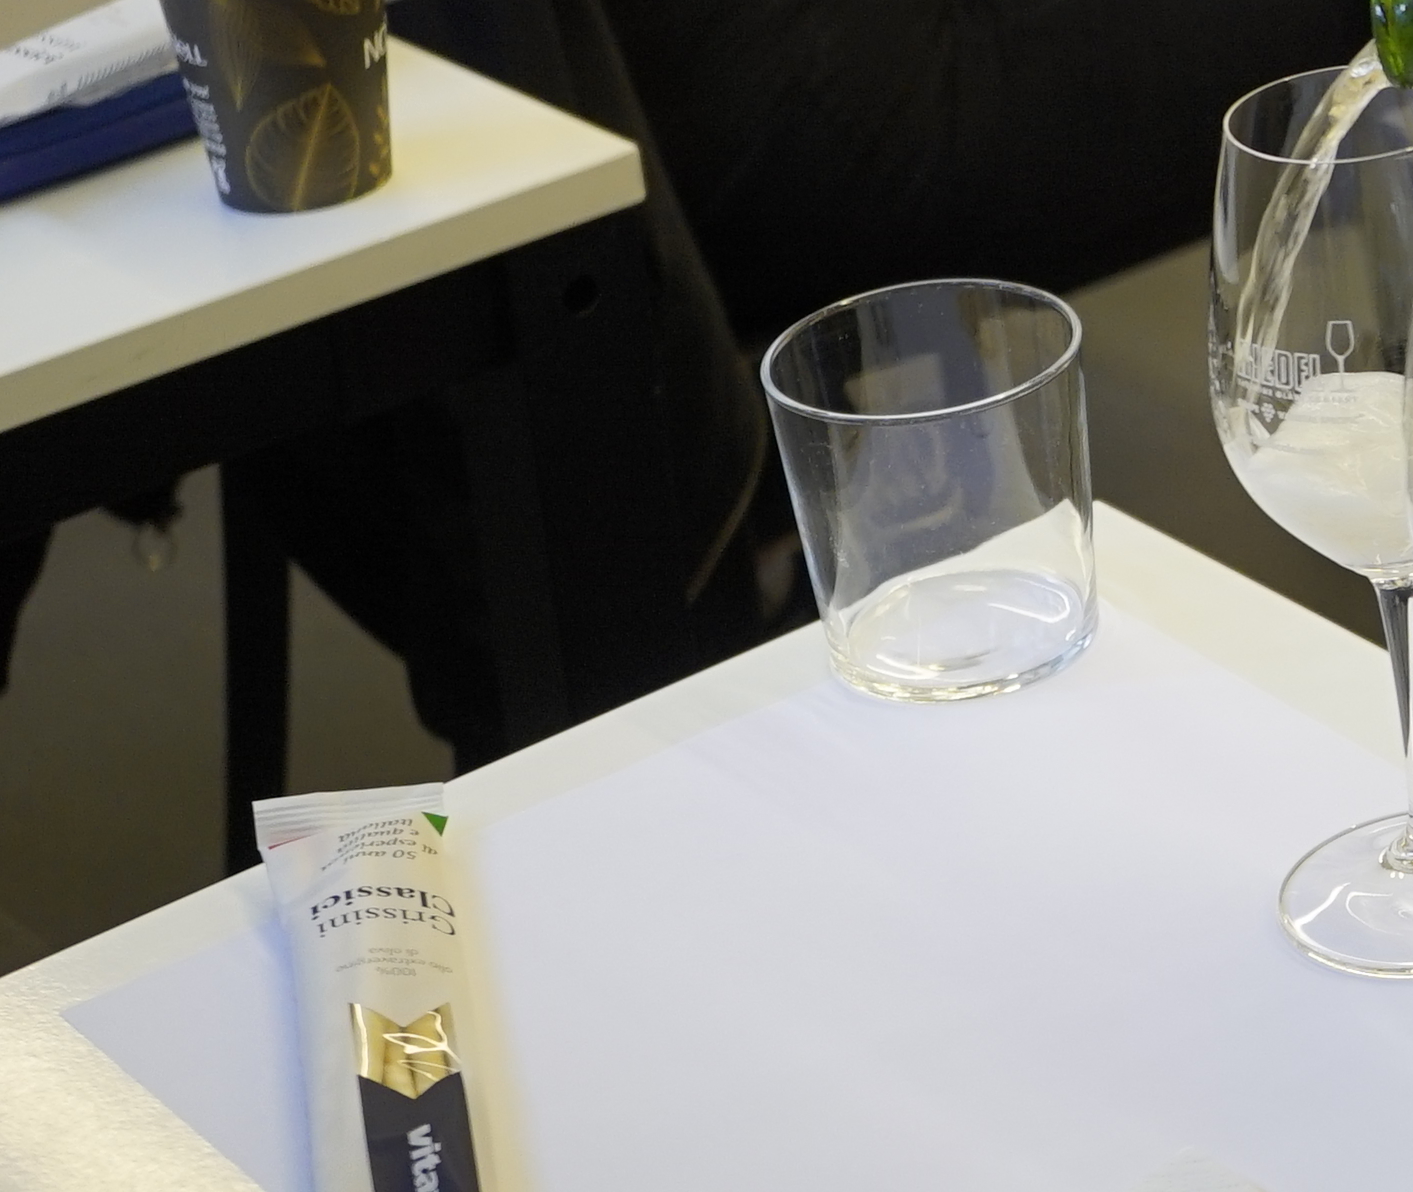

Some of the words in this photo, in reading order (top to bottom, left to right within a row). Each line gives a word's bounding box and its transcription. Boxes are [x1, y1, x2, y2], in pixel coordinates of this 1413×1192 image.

[393, 849, 417, 859] 50
[310, 886, 456, 921] Classici
[317, 907, 456, 938] Grissini
[406, 1123, 441, 1192] vita
